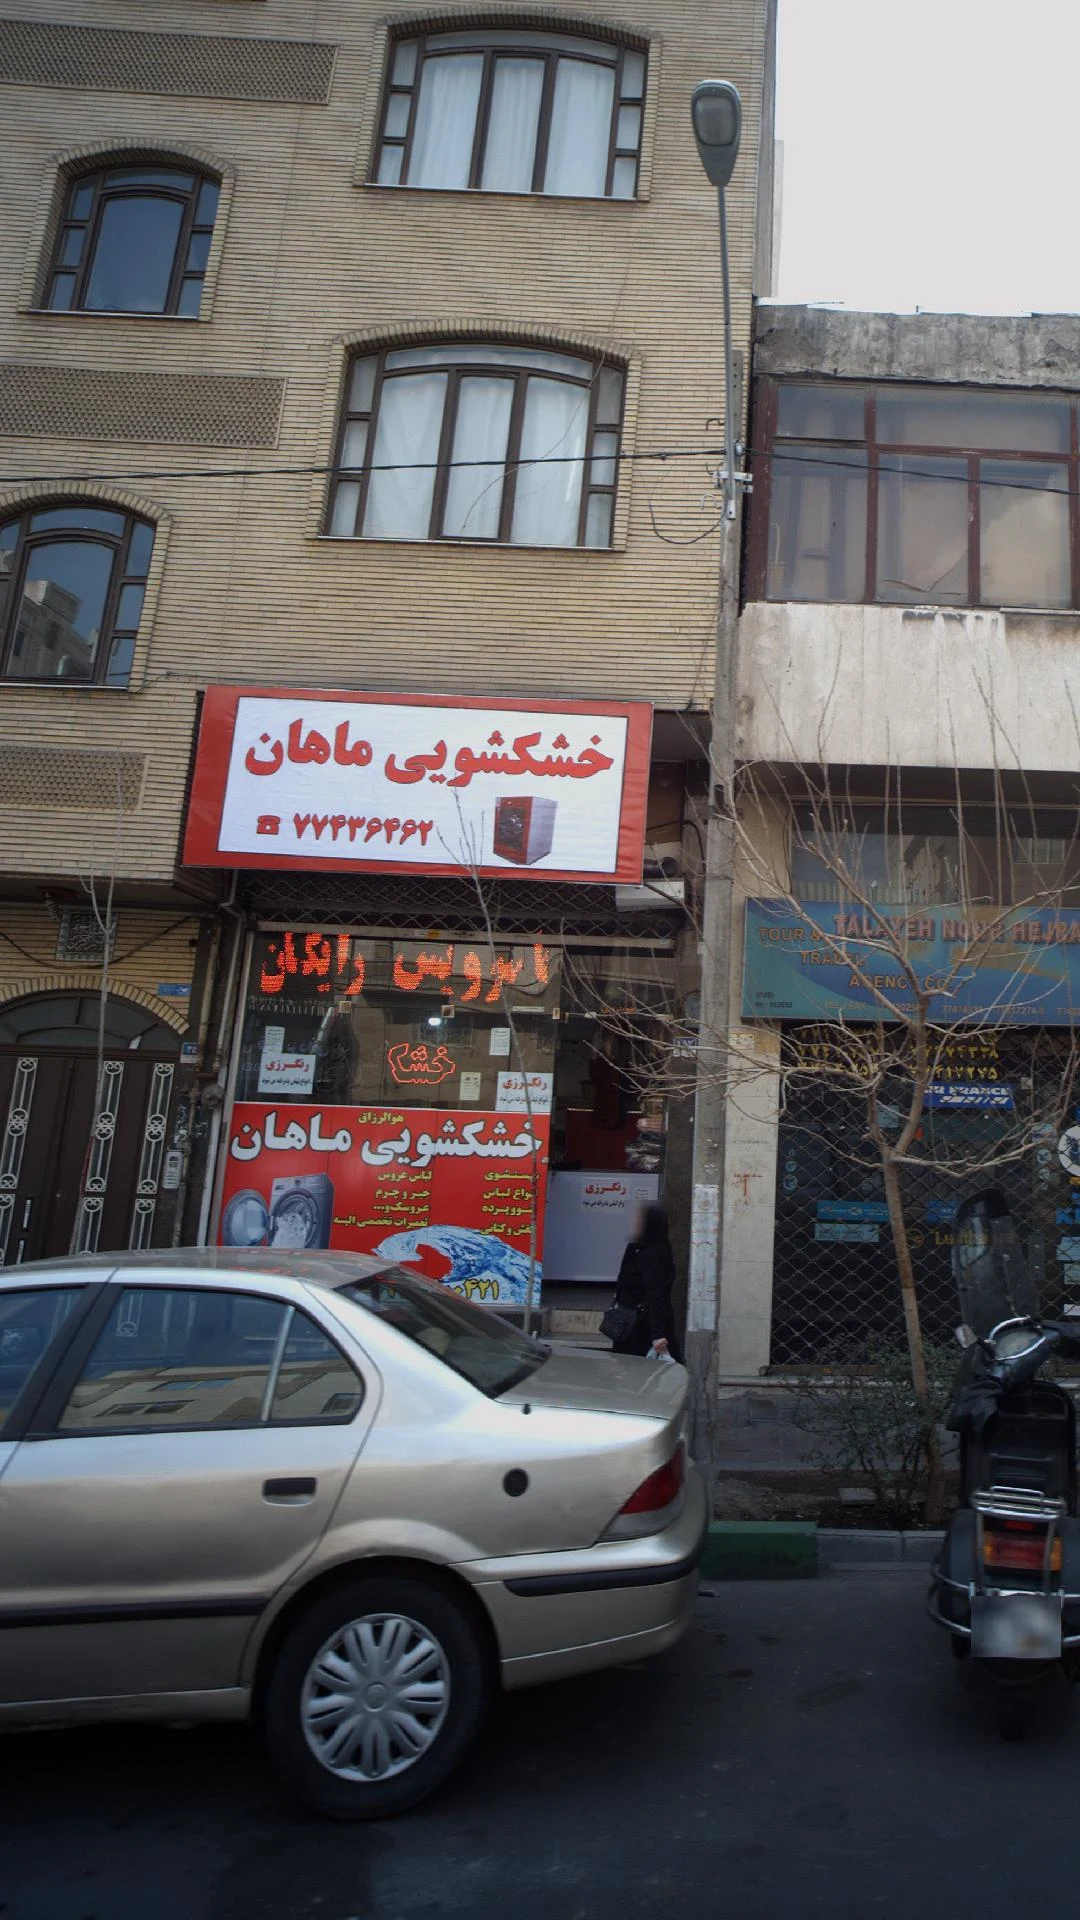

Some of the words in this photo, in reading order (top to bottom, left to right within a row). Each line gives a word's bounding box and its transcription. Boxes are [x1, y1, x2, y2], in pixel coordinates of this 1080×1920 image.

[245, 718, 373, 776] ماهان
[385, 730, 614, 787] خشکشویی
[293, 812, 433, 847] ۷۷۴۳۶۴۶۲
[759, 927, 805, 941] TOUR
[848, 974, 919, 989] AENC
[266, 1057, 310, 1073] رنگرزی
[358, 1111, 404, 1125] هوالرزاق
[230, 1111, 352, 1161] ماهان
[361, 1119, 543, 1167] خشکشویی
[377, 1171, 408, 1182] عروس
[408, 1170, 433, 1182] لباس
[483, 1187, 511, 1200] لباس
